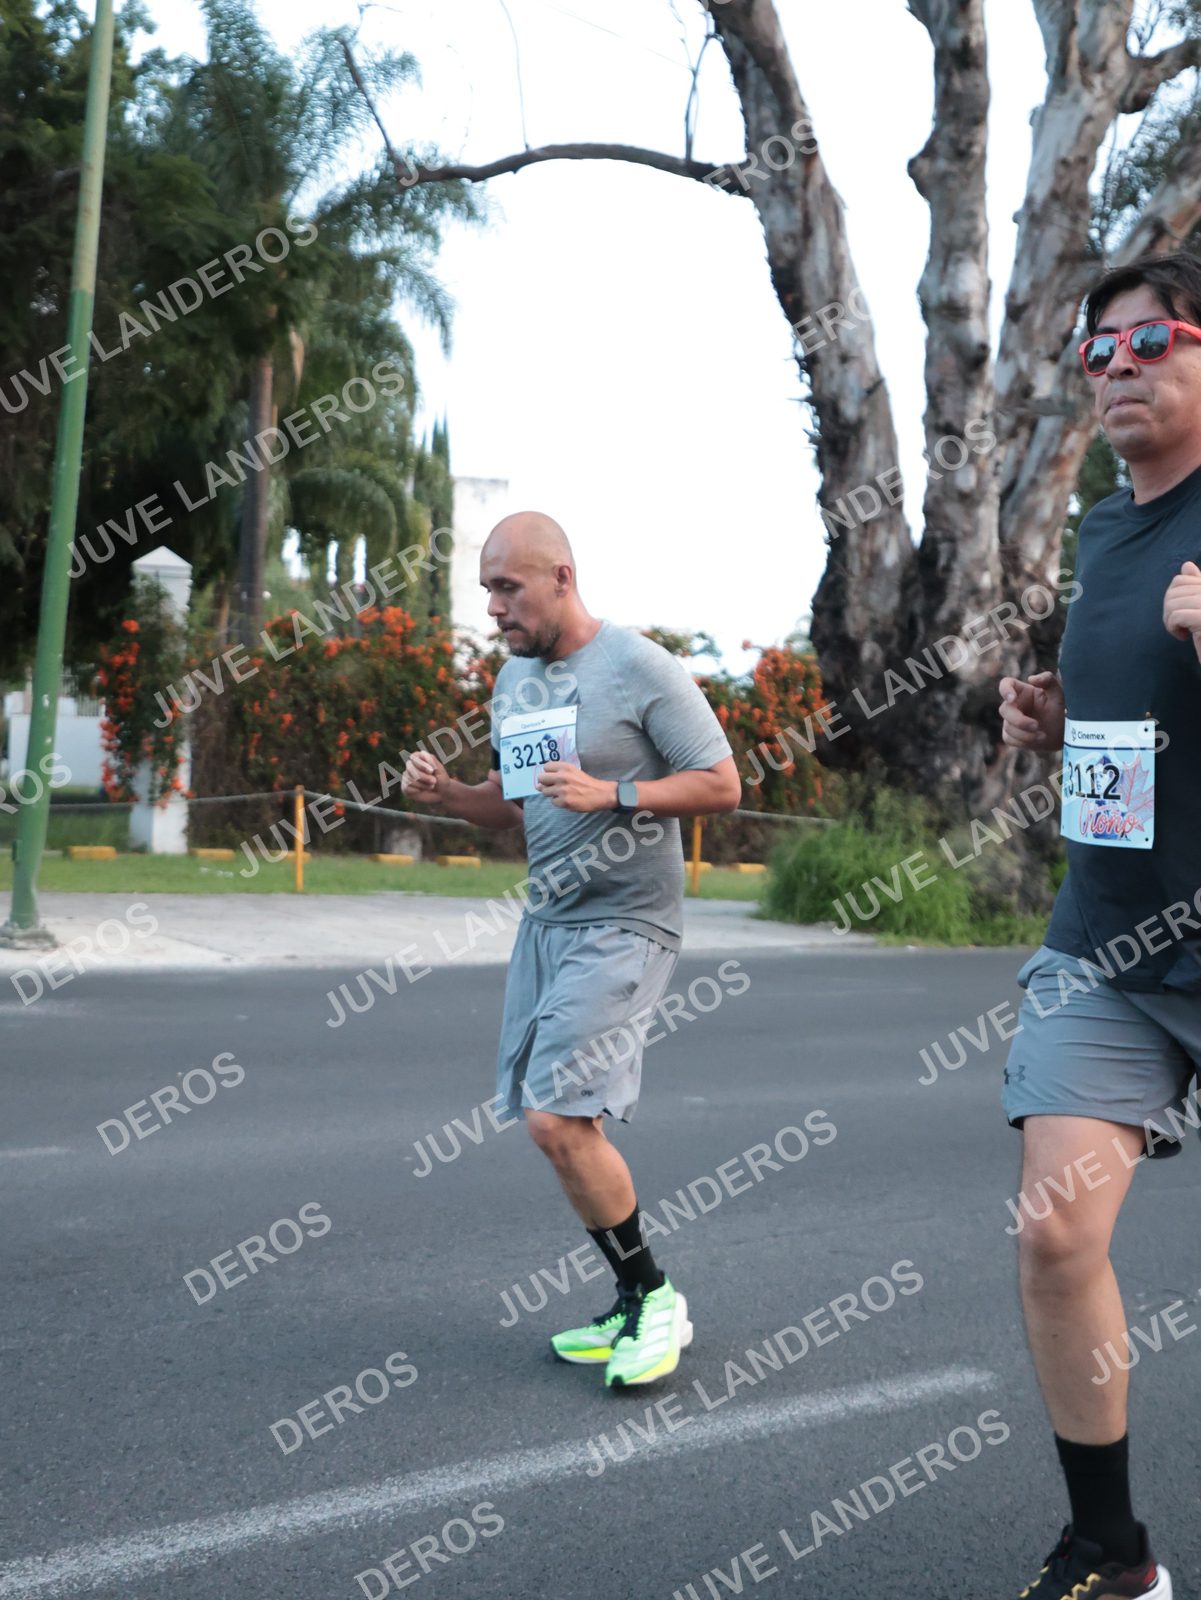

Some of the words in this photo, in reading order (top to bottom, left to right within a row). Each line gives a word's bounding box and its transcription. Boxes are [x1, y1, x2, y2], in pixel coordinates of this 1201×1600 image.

[1077, 731, 1106, 741] Cinemex
[512, 740, 560, 769] 3218
[1068, 761, 1121, 800] 3112
